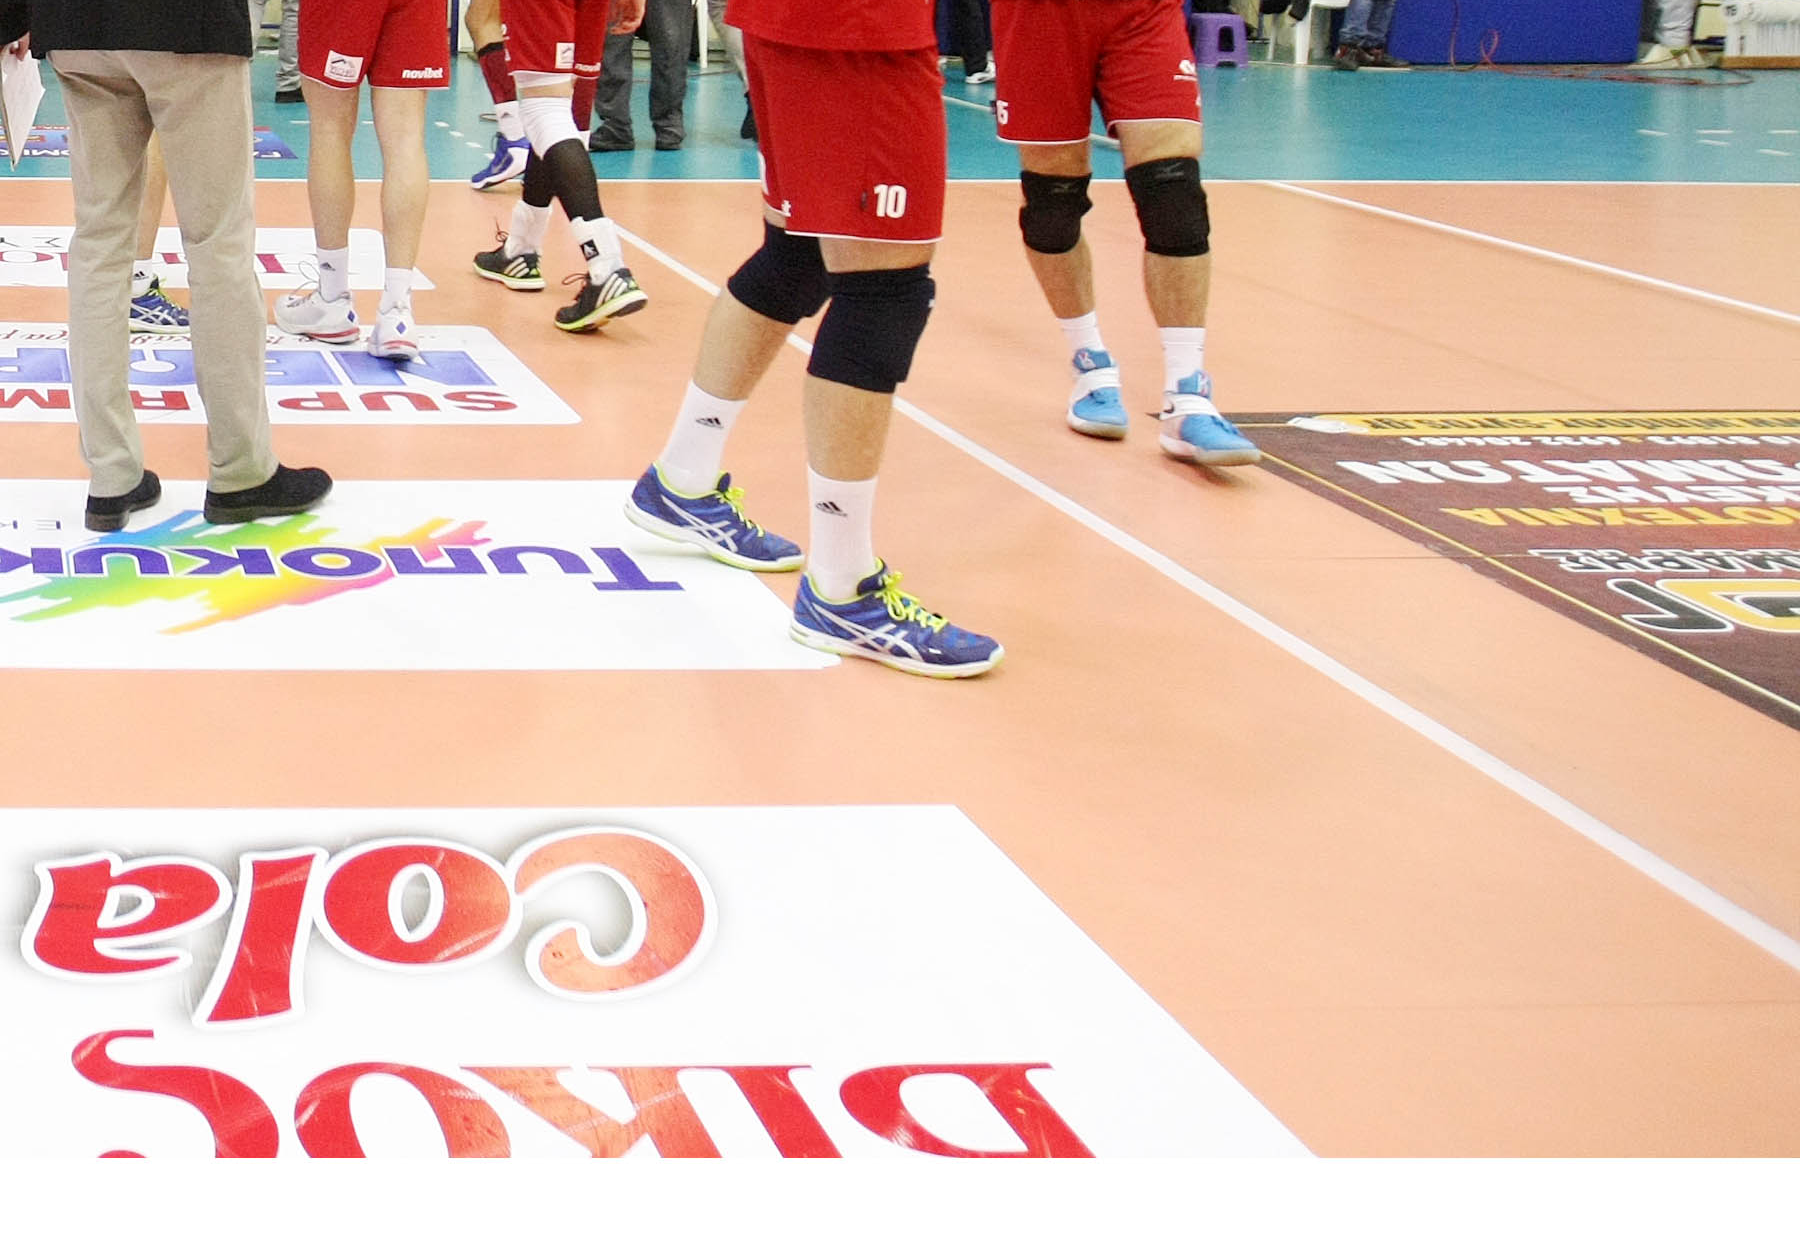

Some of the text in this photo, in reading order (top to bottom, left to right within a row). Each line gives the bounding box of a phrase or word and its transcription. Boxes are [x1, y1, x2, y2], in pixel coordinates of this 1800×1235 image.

[874, 184, 907, 218] 10
[1336, 459, 1800, 484] ΩΜΑΤΩΝ
[28, 828, 711, 1025] Cola
